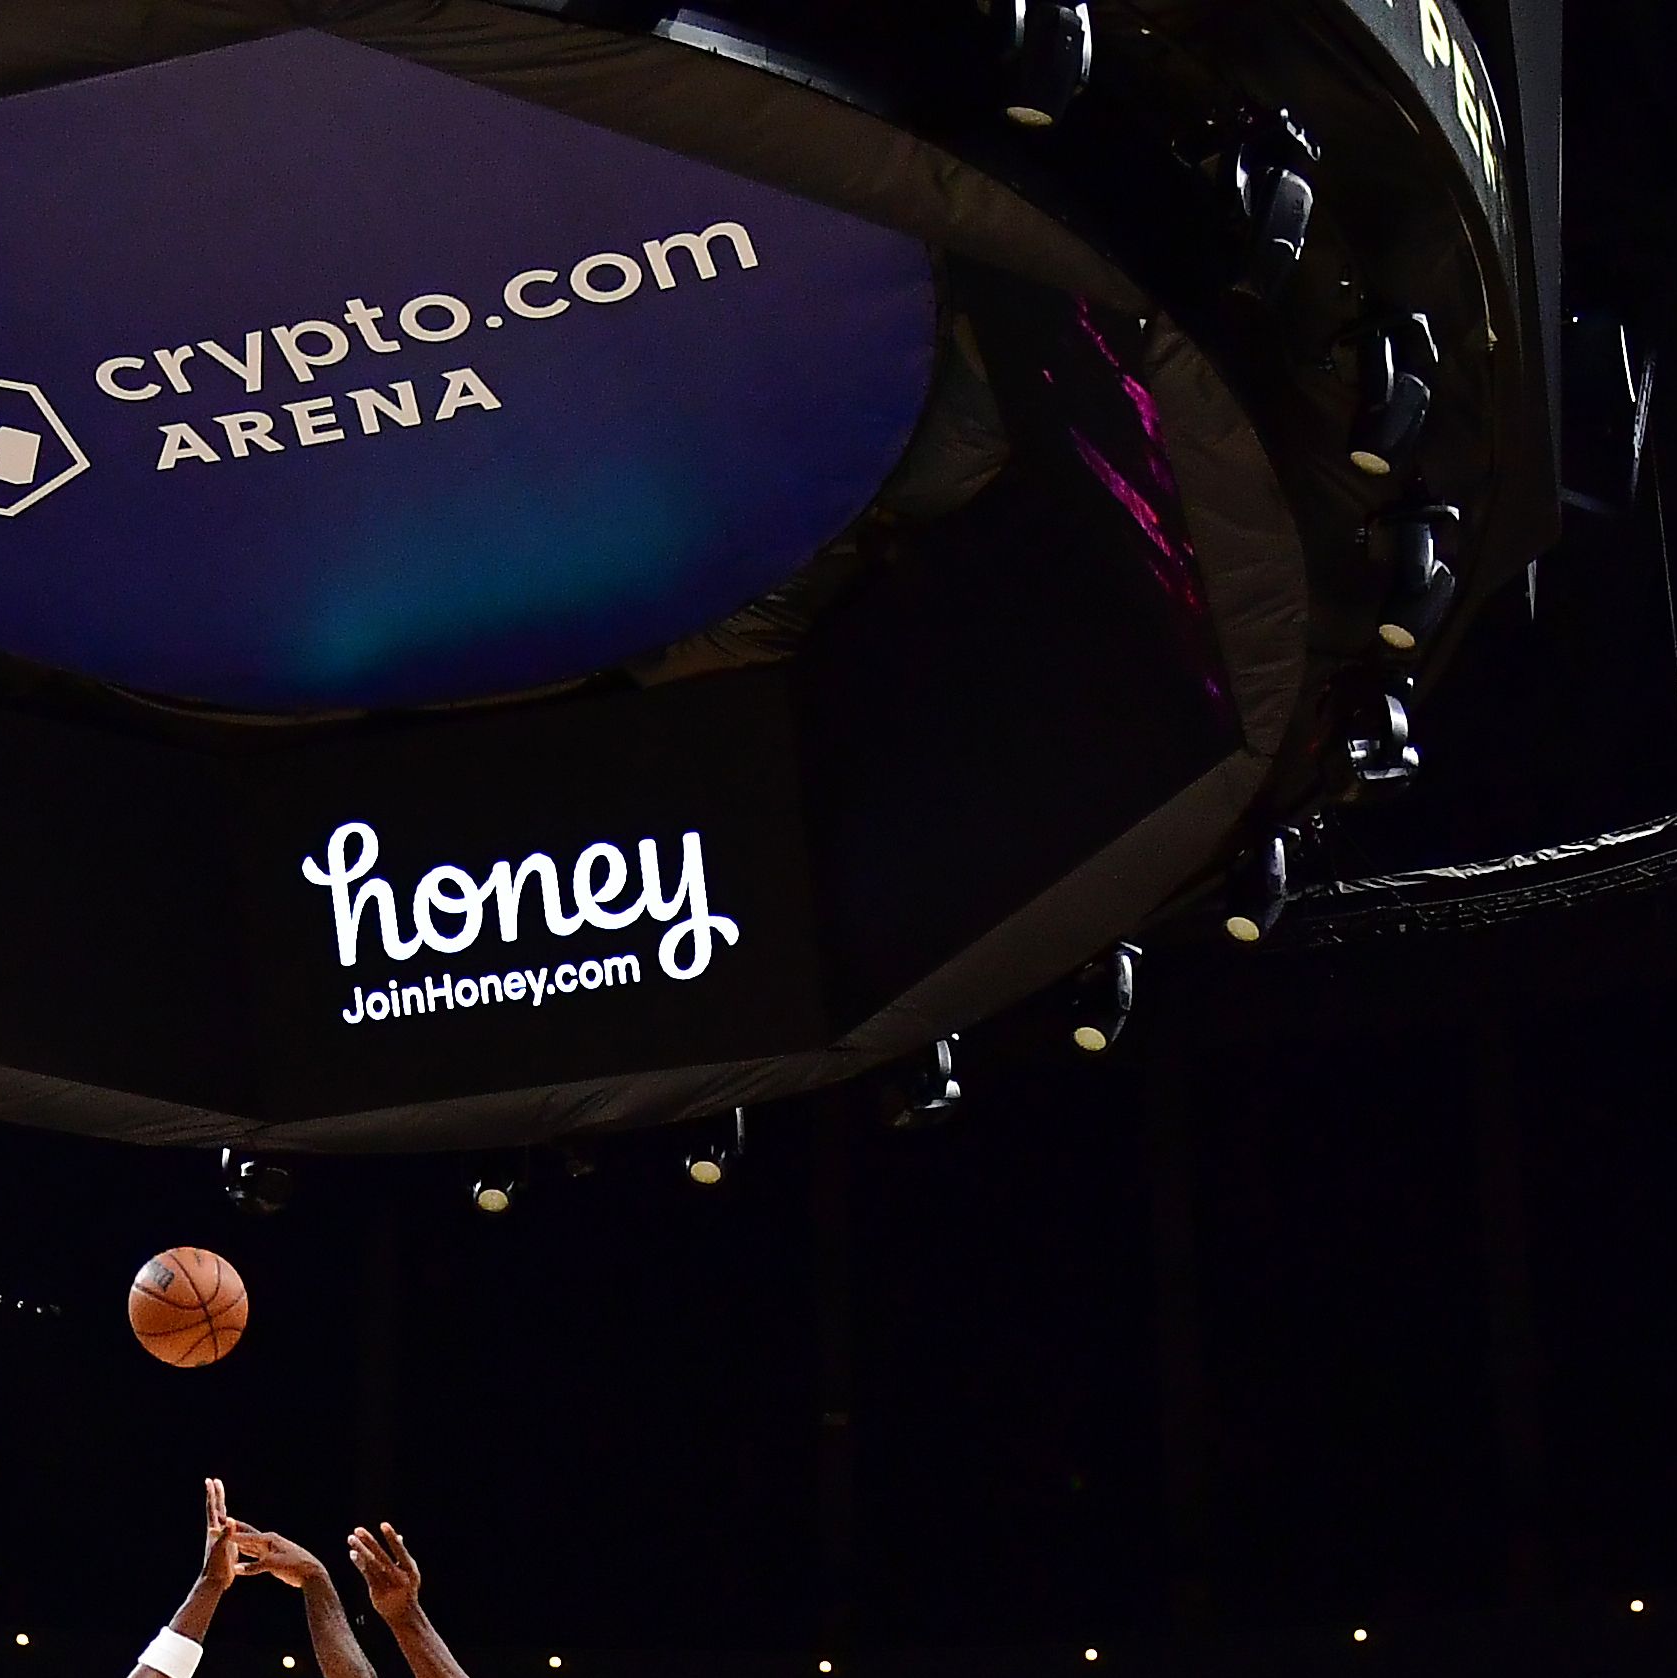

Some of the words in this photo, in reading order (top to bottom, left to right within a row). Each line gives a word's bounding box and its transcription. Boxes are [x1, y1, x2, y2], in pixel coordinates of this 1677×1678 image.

[94, 220, 759, 402] crypto.com
[156, 366, 503, 470] ARENA
[302, 820, 740, 981] honey
[342, 949, 641, 1025] JoinHoney.com
